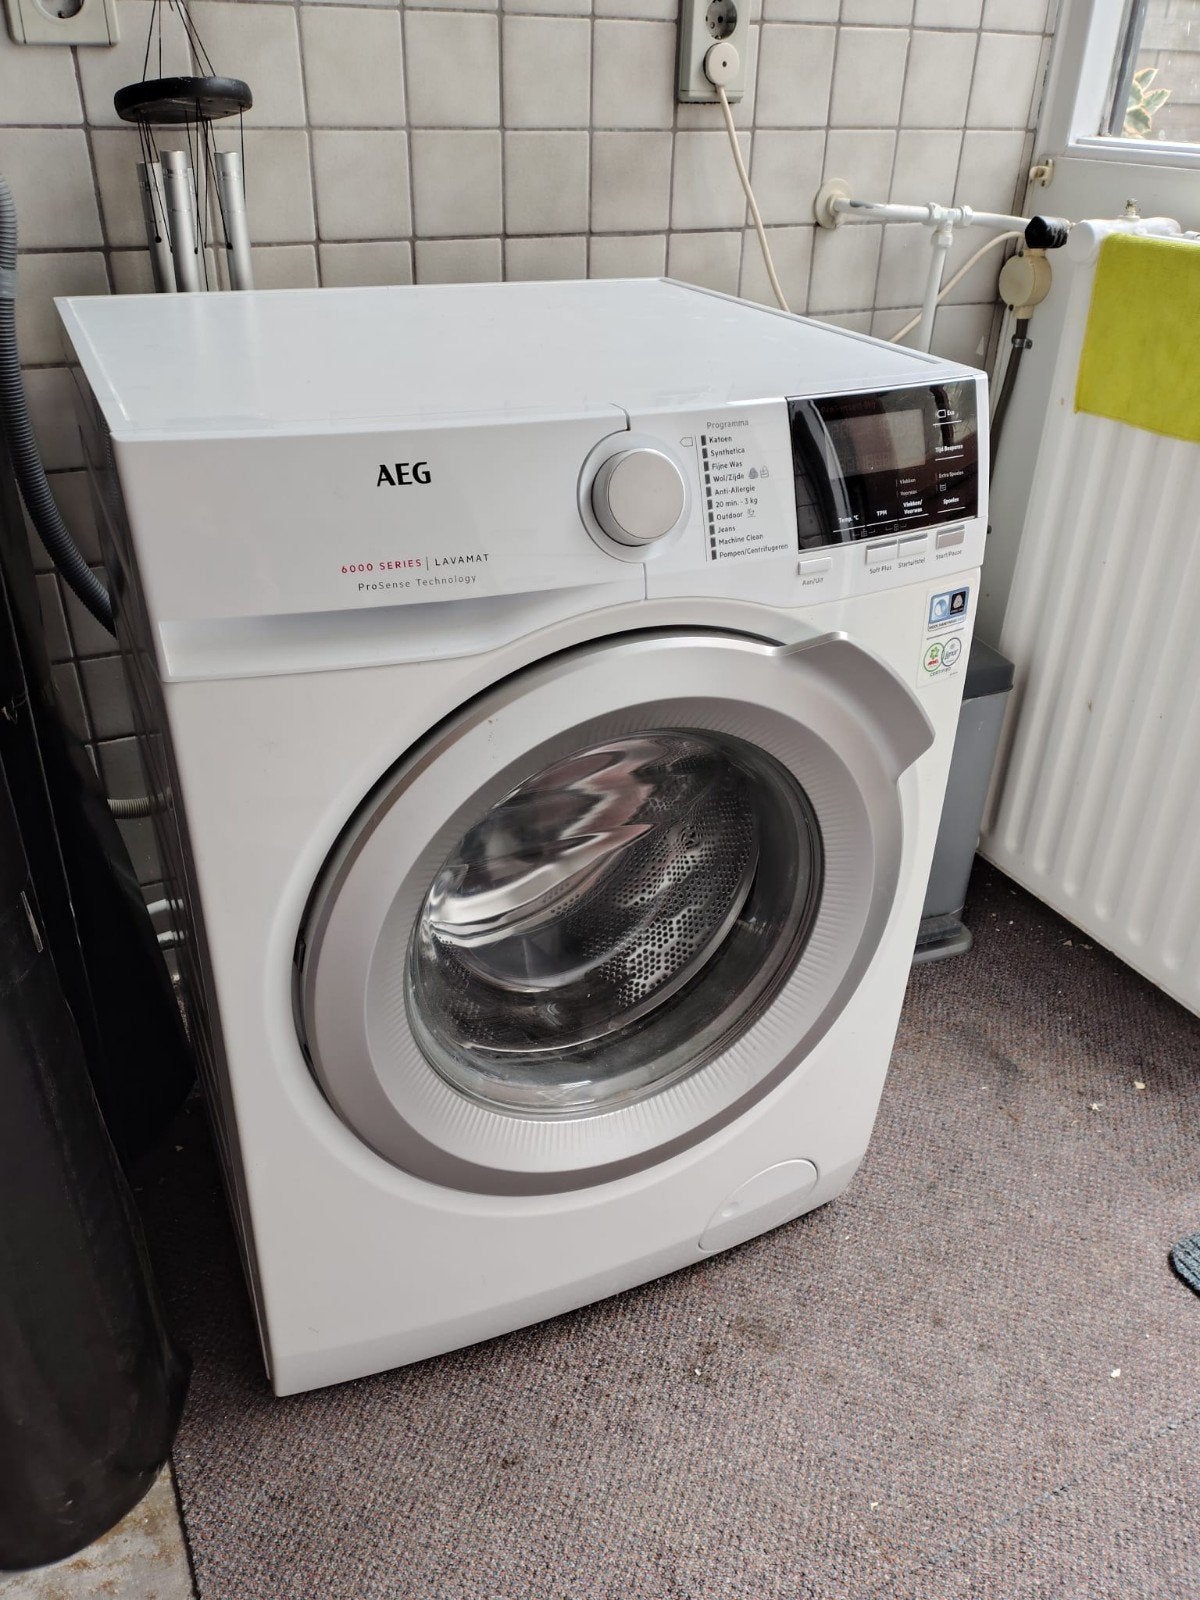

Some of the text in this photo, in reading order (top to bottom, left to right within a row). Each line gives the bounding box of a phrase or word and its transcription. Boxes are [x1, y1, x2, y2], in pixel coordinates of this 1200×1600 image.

[706, 420, 749, 430] Programma
[710, 447, 746, 458] Synthetica
[712, 463, 728, 471] Fijne
[377, 462, 432, 487] AEG
[713, 473, 745, 483] Wol/Zijde
[715, 485, 756, 496] Anti-Allergie
[745, 497, 749, 505] 3
[750, 497, 758, 505] kg
[716, 512, 743, 521] Outdoor
[720, 544, 789, 558] Pompen/Centrifugeren
[341, 553, 490, 574] 6000 SERIES LAVAMAT
[358, 575, 477, 592] ProSense Technology
